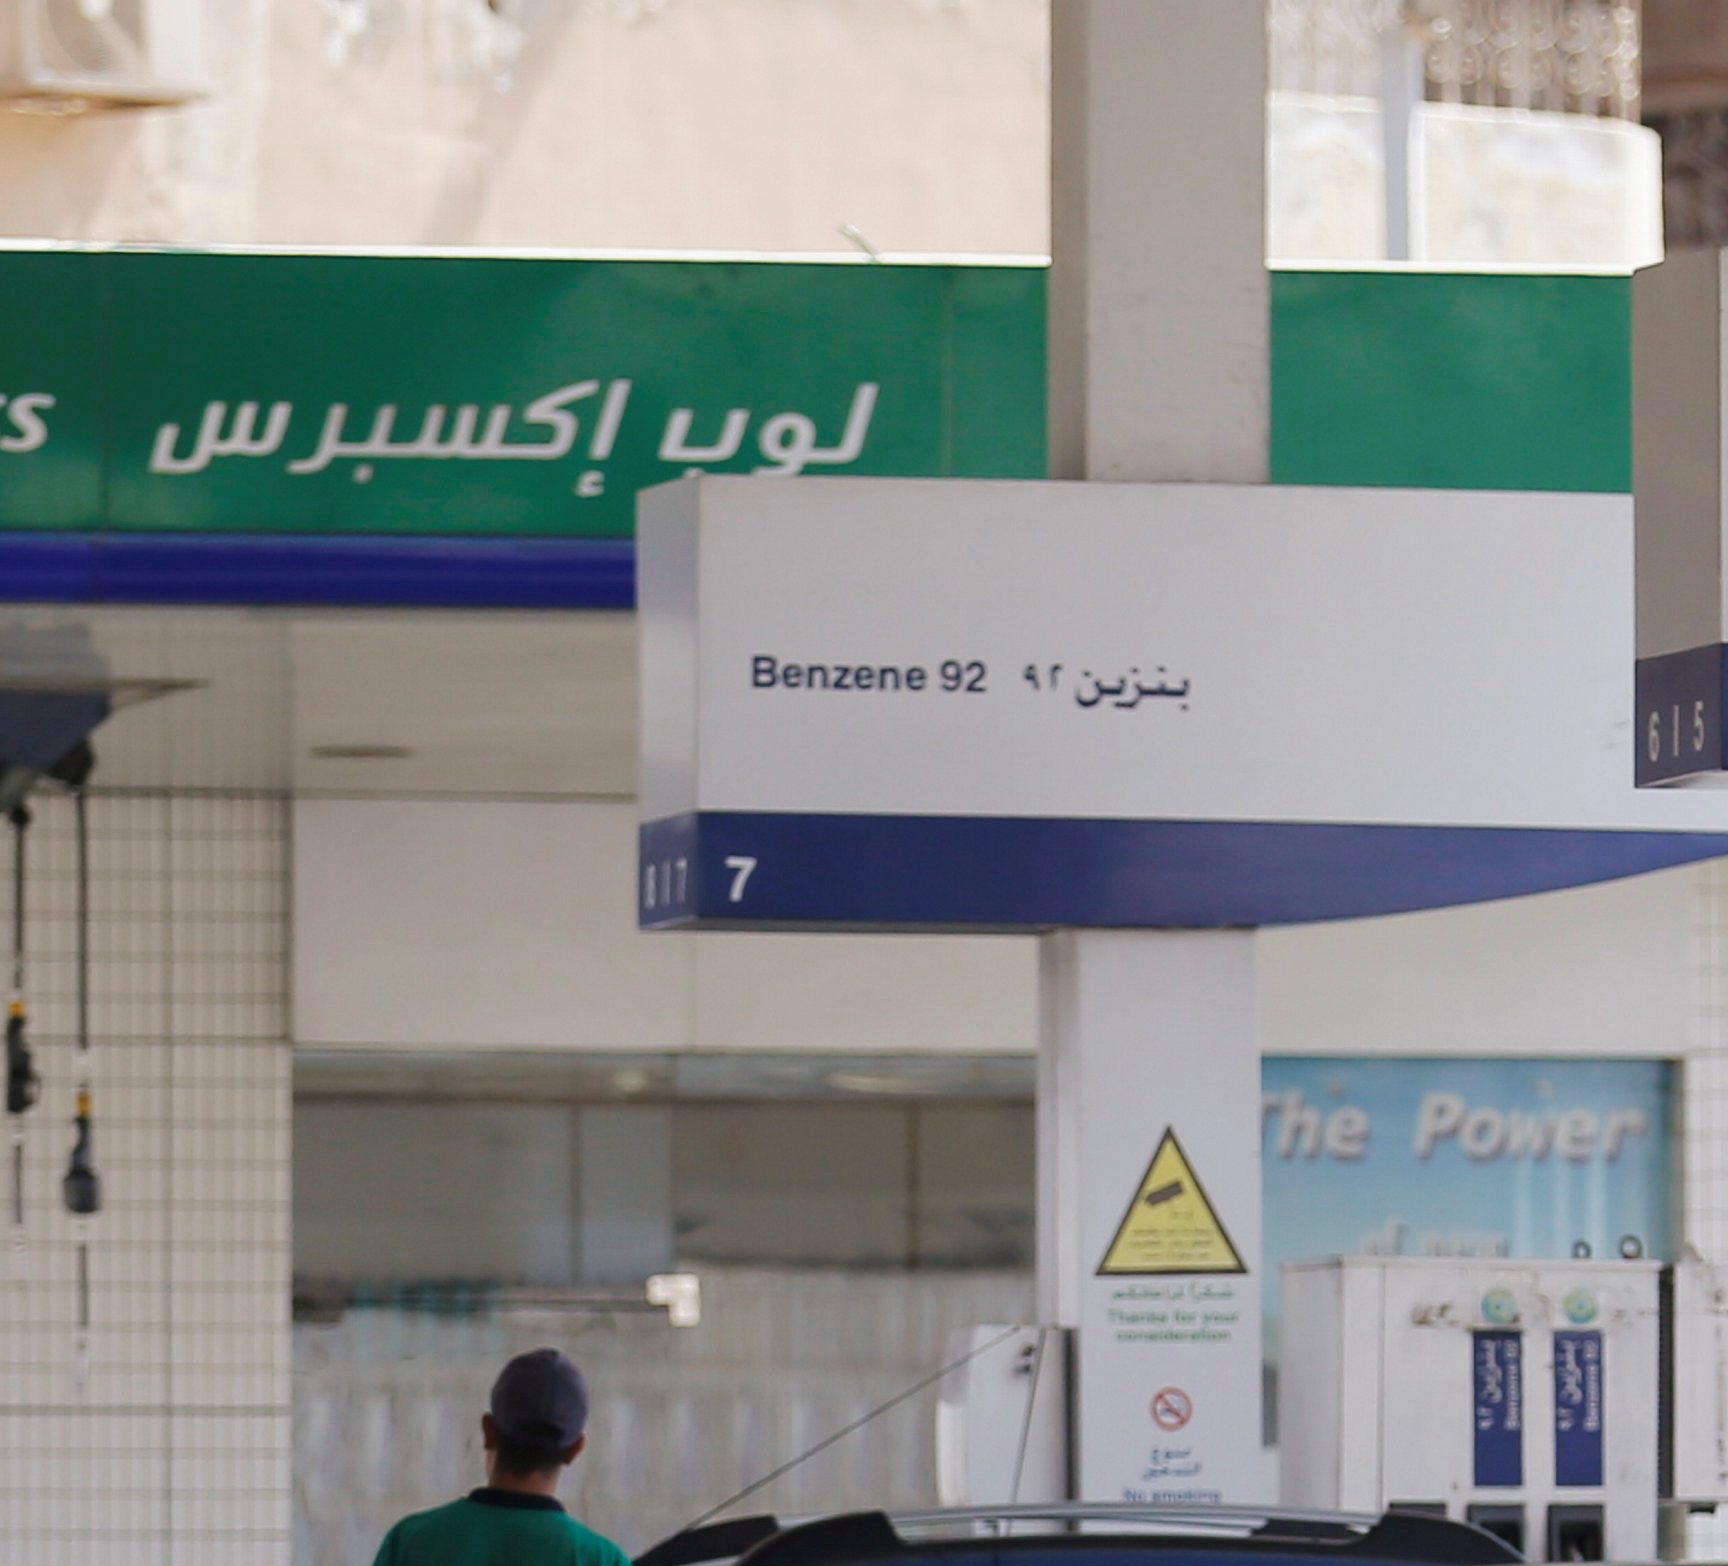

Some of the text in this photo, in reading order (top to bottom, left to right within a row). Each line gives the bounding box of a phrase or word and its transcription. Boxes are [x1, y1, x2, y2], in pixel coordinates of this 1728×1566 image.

[148, 378, 632, 498] إكسبرس
[751, 655, 989, 693] Benzene 92
[1075, 664, 1190, 710] بنزين
[1647, 700, 1705, 763] 6 5
[724, 855, 758, 903] 7
[1415, 1091, 1647, 1164] Power
